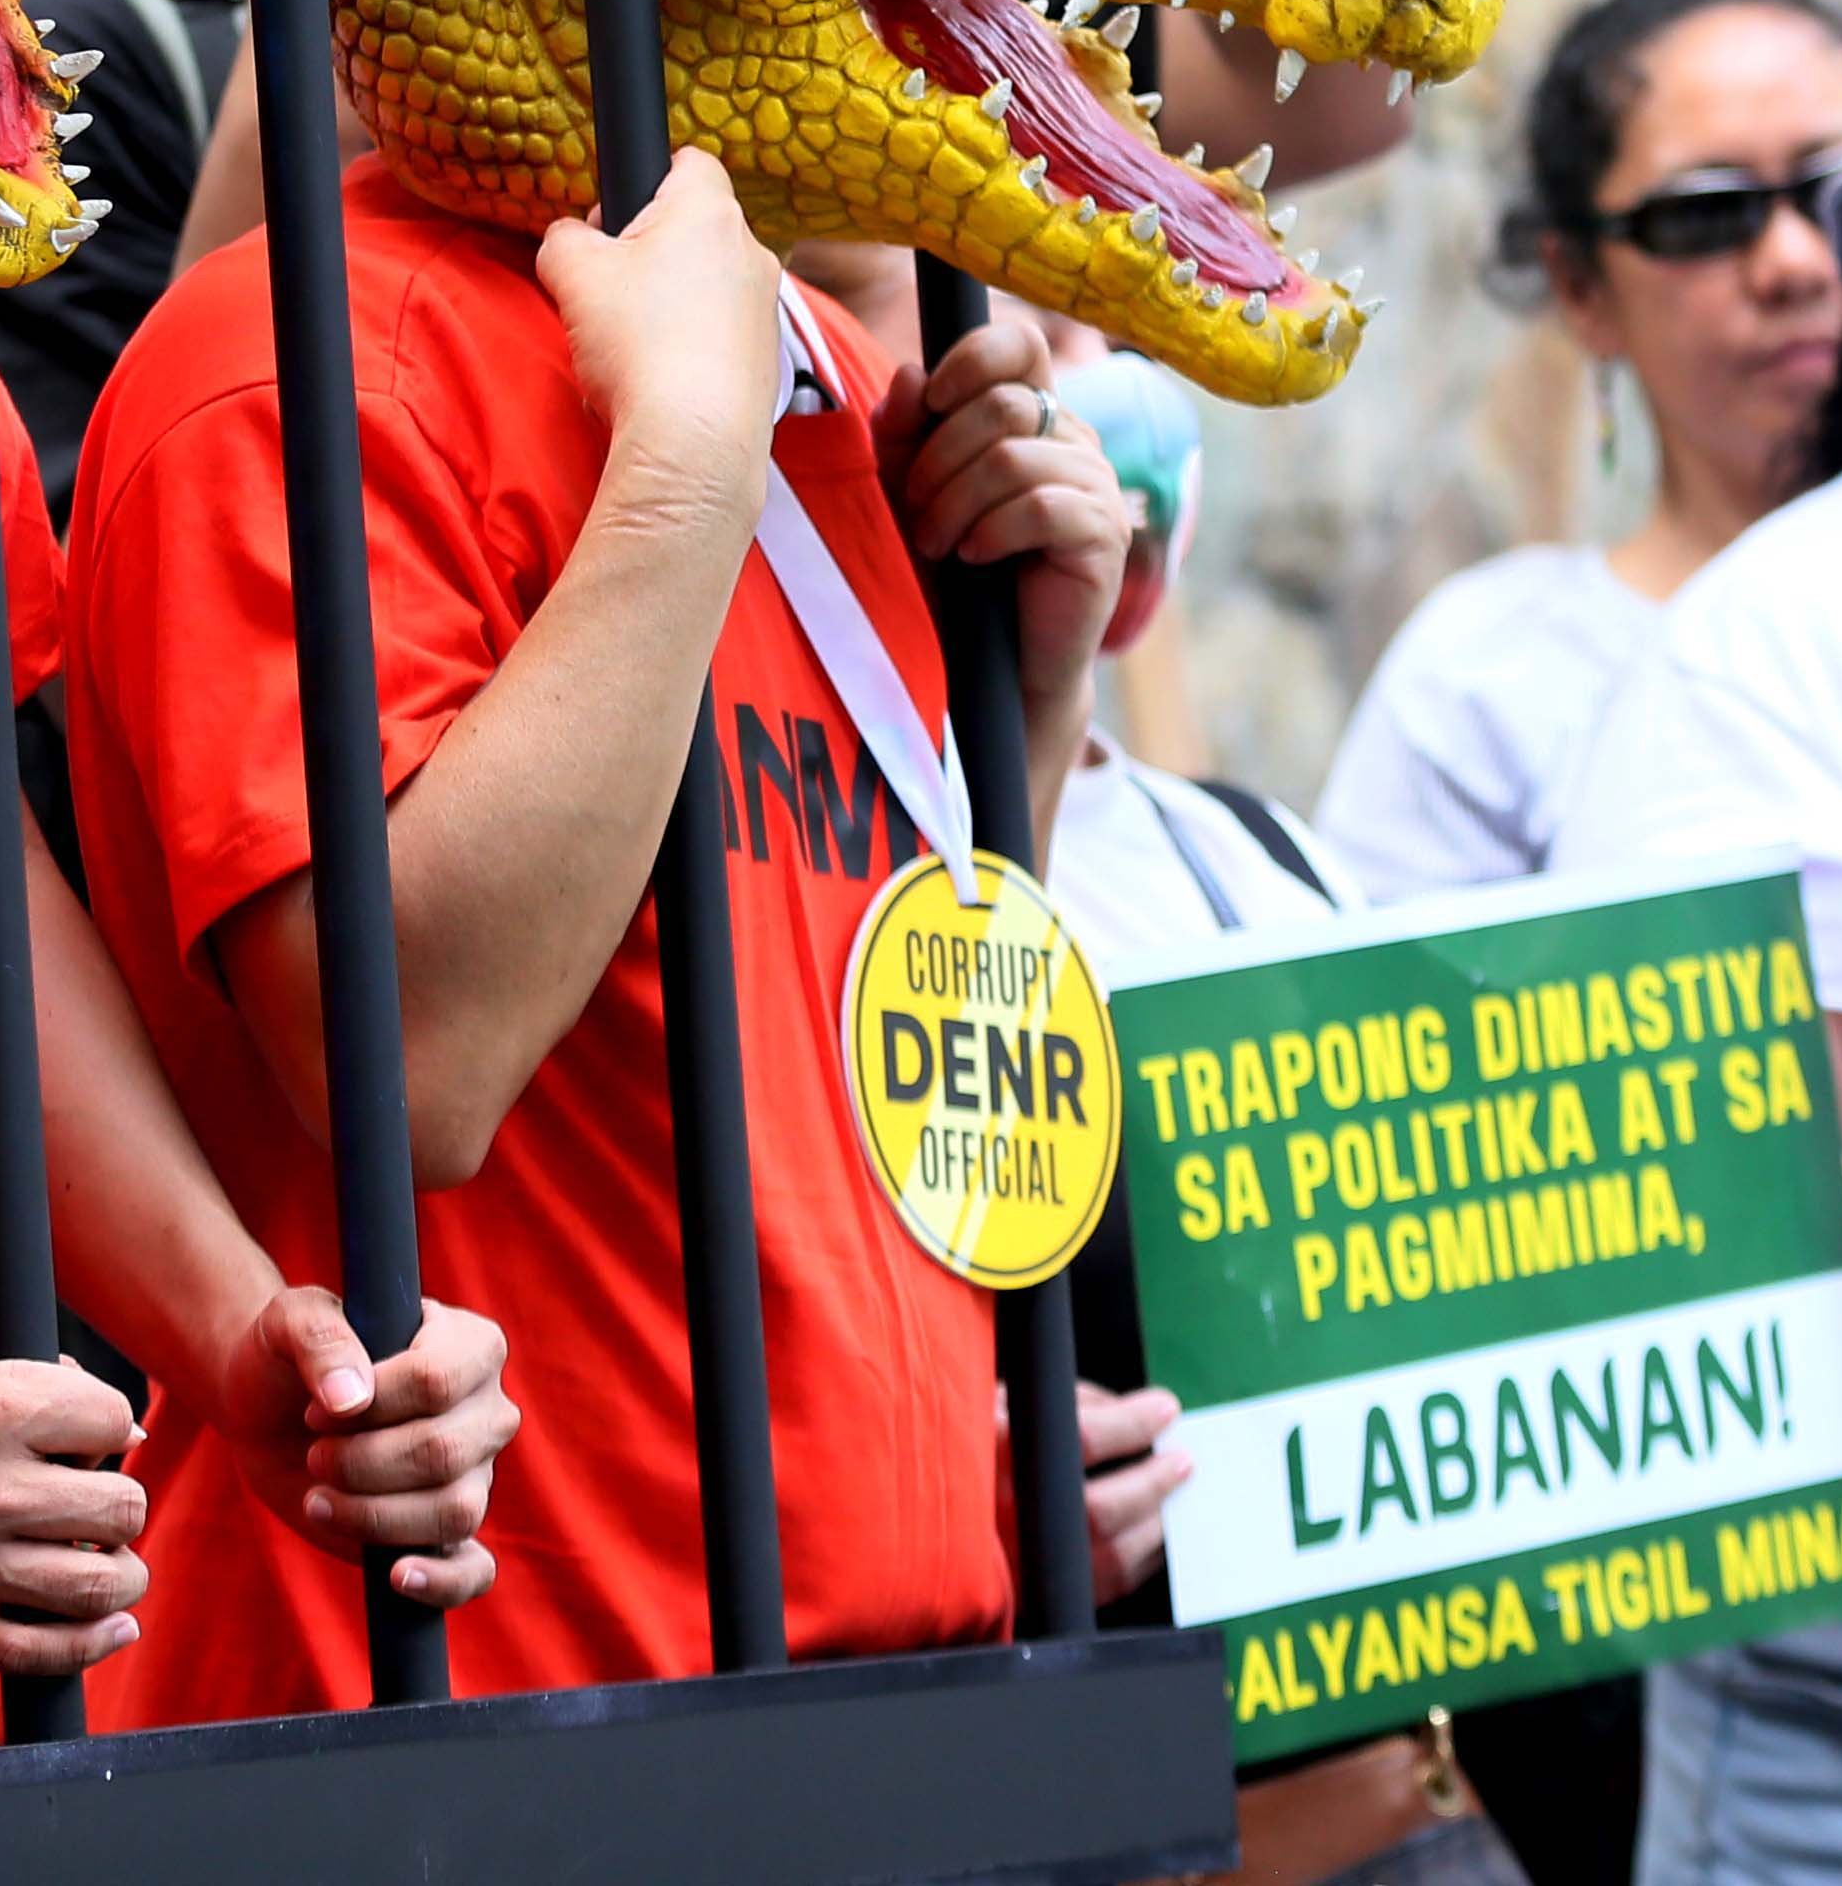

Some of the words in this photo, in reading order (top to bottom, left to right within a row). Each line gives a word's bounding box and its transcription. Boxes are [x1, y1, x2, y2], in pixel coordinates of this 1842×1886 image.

[906, 929, 1055, 1014] CORRUPT
[1138, 1006, 1452, 1143] TRAPONG
[1473, 940, 1814, 1083] DINASTIYA
[880, 1009, 1088, 1128] DENR
[1176, 1143, 1269, 1241] SA
[1287, 1084, 1597, 1222] POLITIKA
[1619, 1061, 1699, 1155] AT
[1723, 1040, 1812, 1136] SA
[919, 1125, 1065, 1207] OFFICIAL
[1294, 1164, 1705, 1322] PAGMIMINA,
[1284, 1320, 1796, 1553] LABANAN!
[1227, 1576, 1538, 1722] ALYANSA
[1541, 1537, 1709, 1645] TIGIL
